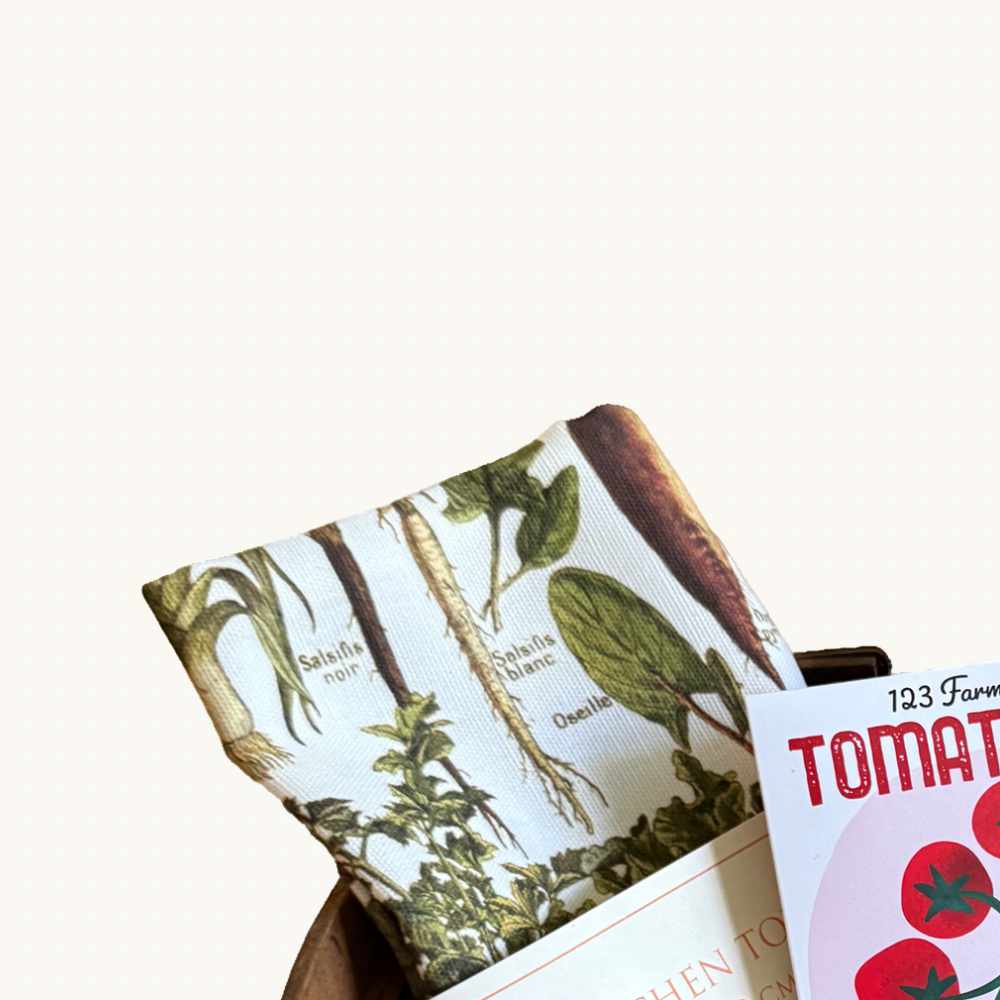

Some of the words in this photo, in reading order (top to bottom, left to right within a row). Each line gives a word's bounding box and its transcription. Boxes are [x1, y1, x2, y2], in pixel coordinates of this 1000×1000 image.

[298, 641, 364, 672] Salsifis
[491, 634, 556, 668] Salsifis
[323, 661, 359, 685] noir
[504, 654, 556, 682] blanc
[552, 695, 613, 730] Oseille
[888, 684, 934, 713] 123
[733, 915, 788, 961] TO
